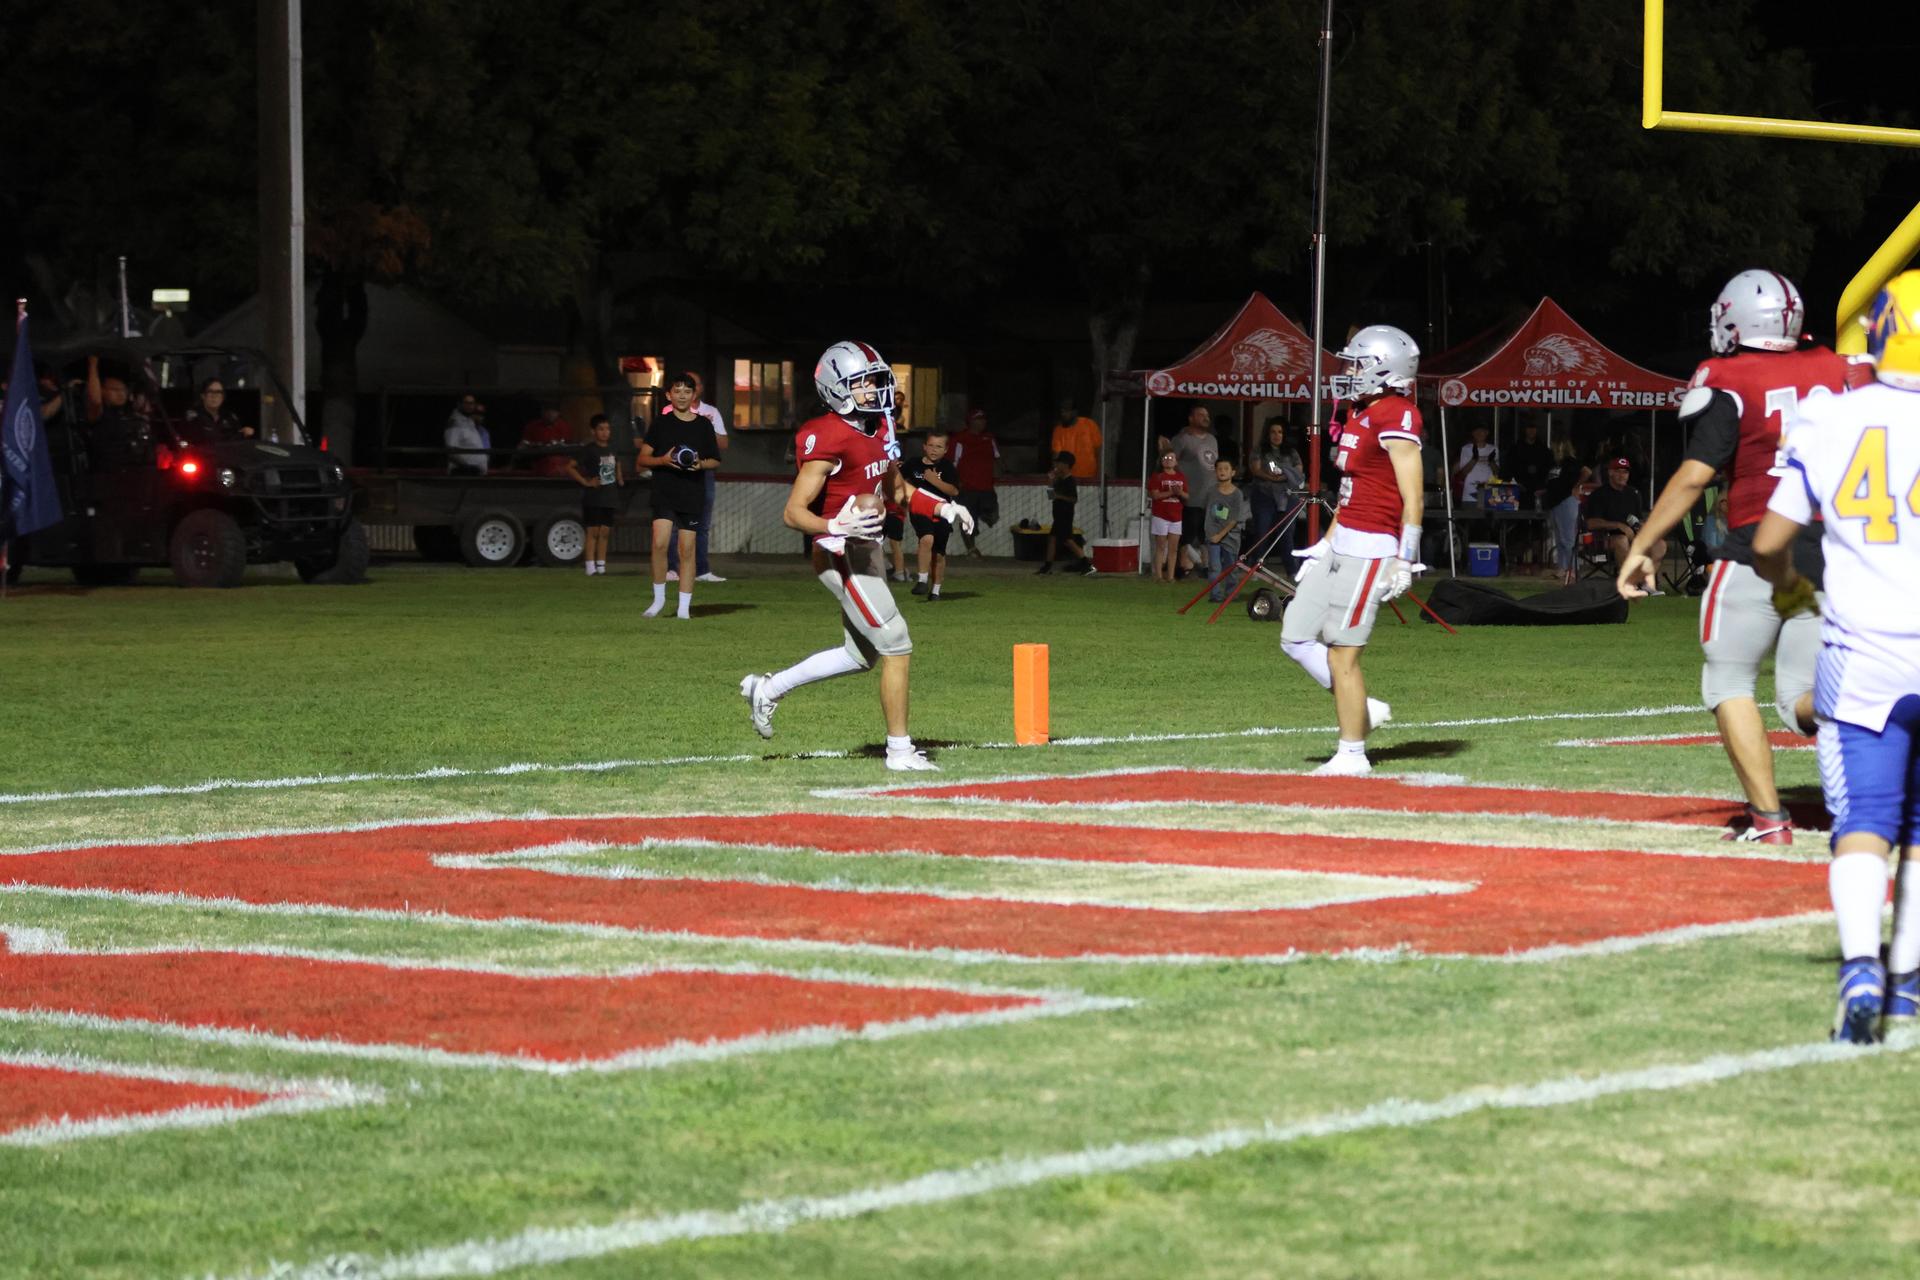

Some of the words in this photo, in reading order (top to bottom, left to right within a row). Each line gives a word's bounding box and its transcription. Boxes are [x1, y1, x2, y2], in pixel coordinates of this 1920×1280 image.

[1218, 373, 1265, 381] HOME
[1510, 379, 1557, 388] HOME
[1567, 380, 1588, 388] OF
[1598, 381, 1628, 389] THE
[1177, 382, 1312, 399] CHOWCHILLA
[1469, 389, 1602, 405] CHOWCHILLA
[1609, 390, 1666, 406] TRIBE
[804, 434, 816, 455] 9
[1832, 426, 1920, 544] 4
